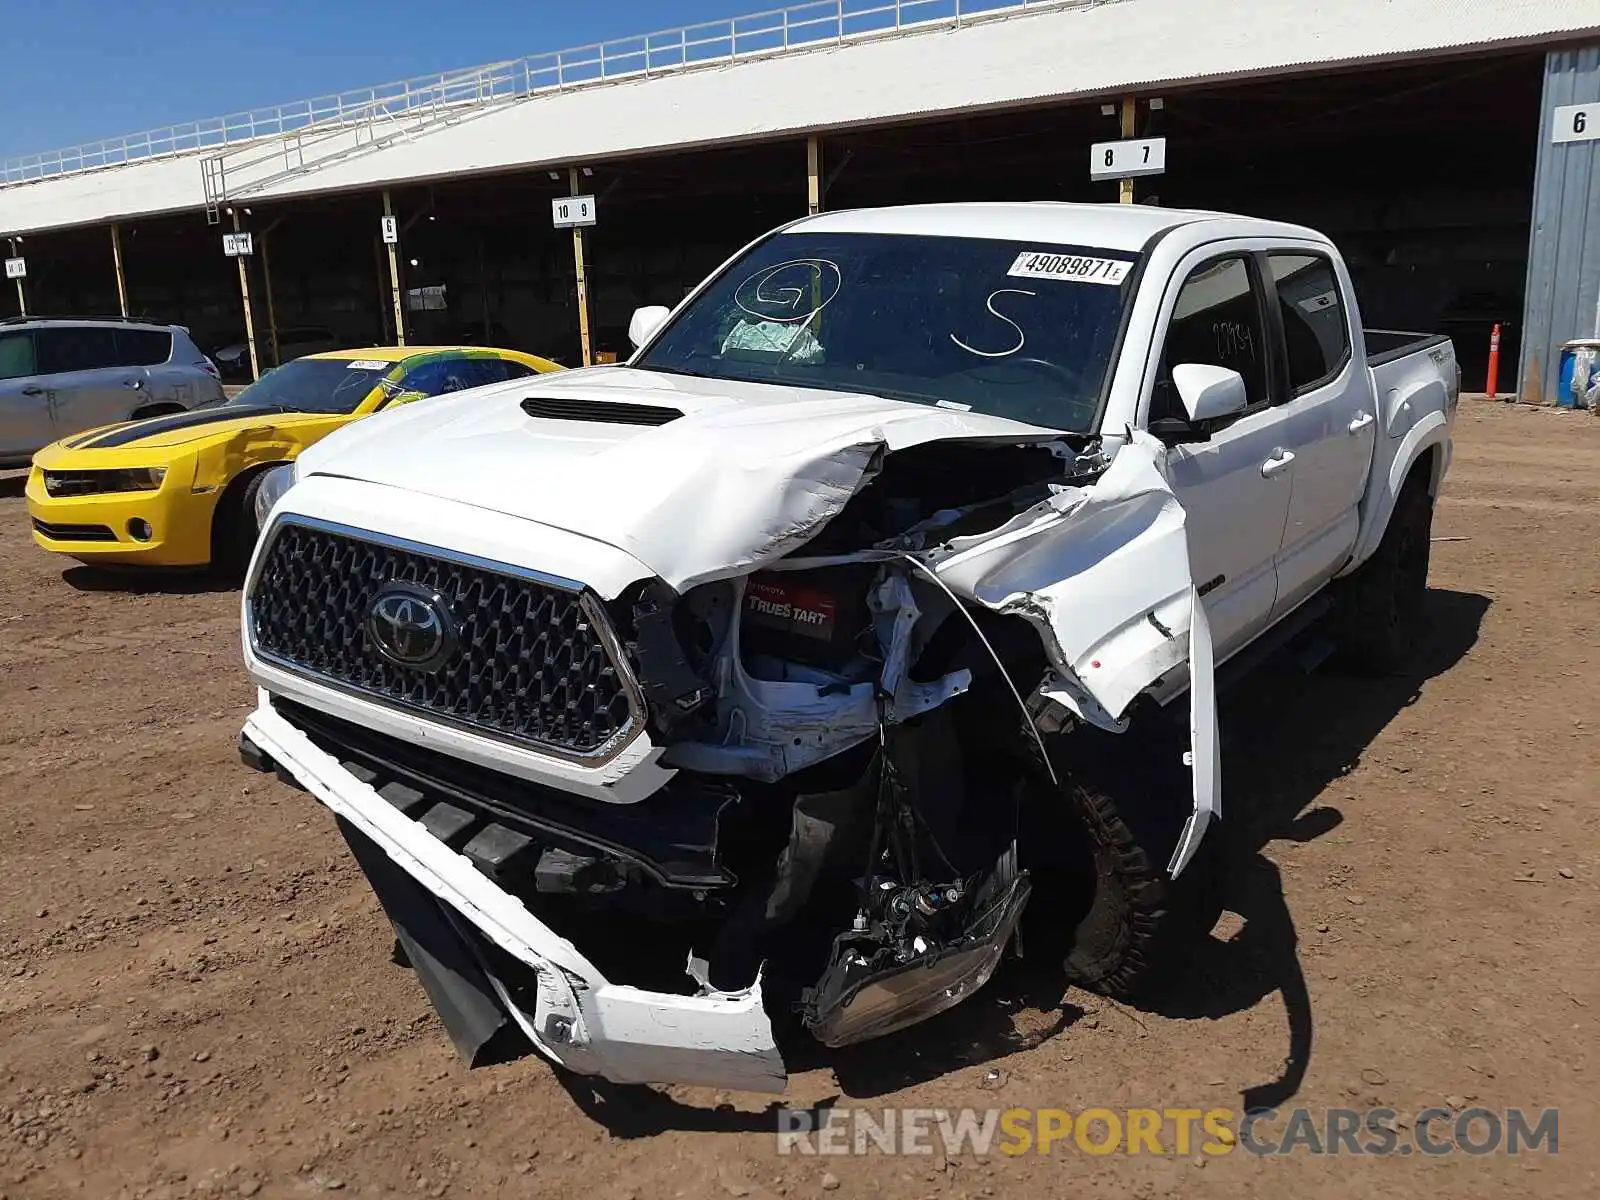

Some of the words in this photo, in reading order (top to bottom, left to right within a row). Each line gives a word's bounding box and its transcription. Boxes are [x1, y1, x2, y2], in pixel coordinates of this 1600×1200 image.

[1573, 111, 1587, 133] 6
[1104, 149, 1114, 167] 8
[1142, 145, 1151, 164] 7
[557, 204, 569, 219] 10
[581, 203, 588, 217] 9
[1025, 255, 1115, 278] 49089871
[950, 288, 1036, 357] S
